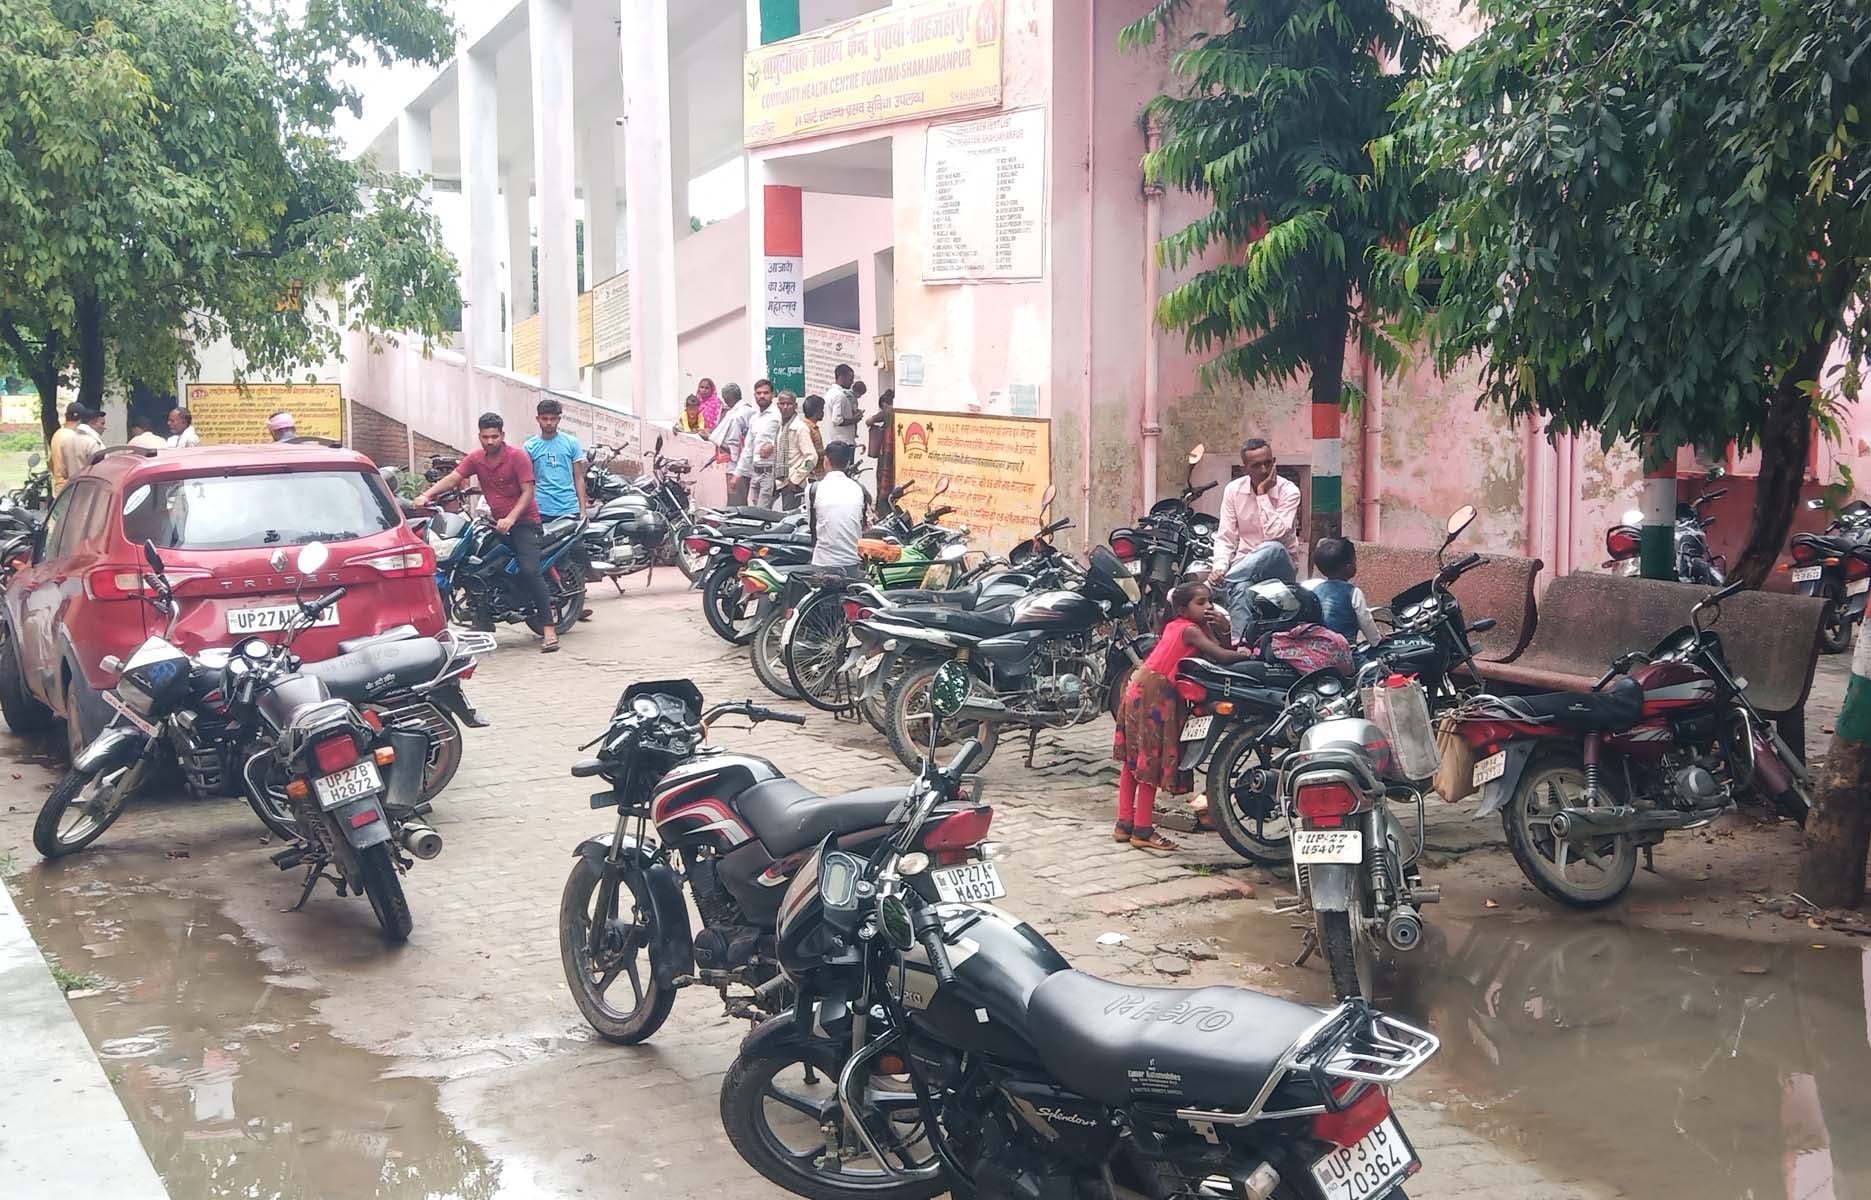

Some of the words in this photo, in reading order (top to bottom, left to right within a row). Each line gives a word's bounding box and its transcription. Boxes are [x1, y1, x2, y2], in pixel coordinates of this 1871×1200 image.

[802, 79, 830, 100] HEALTH
[830, 73, 859, 94] CENTRE
[326, 765, 369, 788] UP27B
[330, 778, 374, 801] H2872
[947, 864, 991, 886] UP27A
[1328, 1124, 1387, 1179] UP31B
